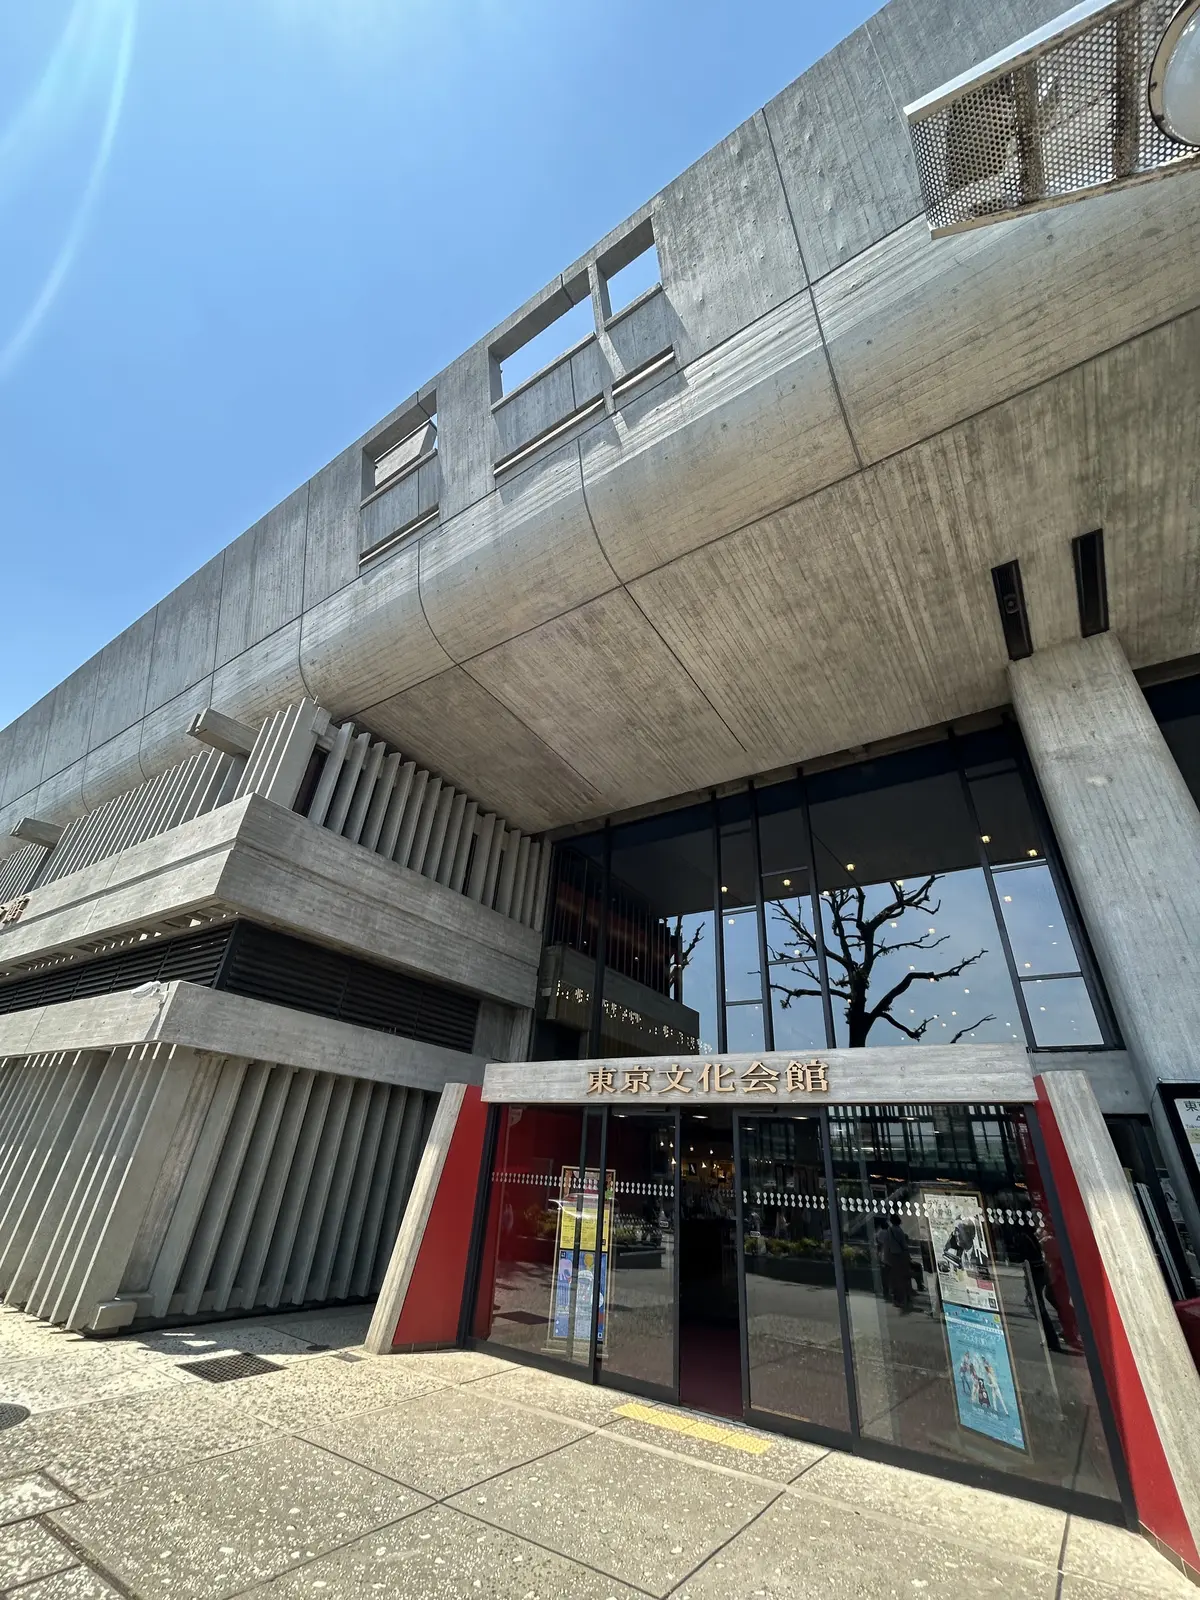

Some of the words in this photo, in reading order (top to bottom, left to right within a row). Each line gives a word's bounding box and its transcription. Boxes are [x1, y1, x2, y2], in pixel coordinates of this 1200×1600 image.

[586, 1059, 829, 1094] 東京文化会館
